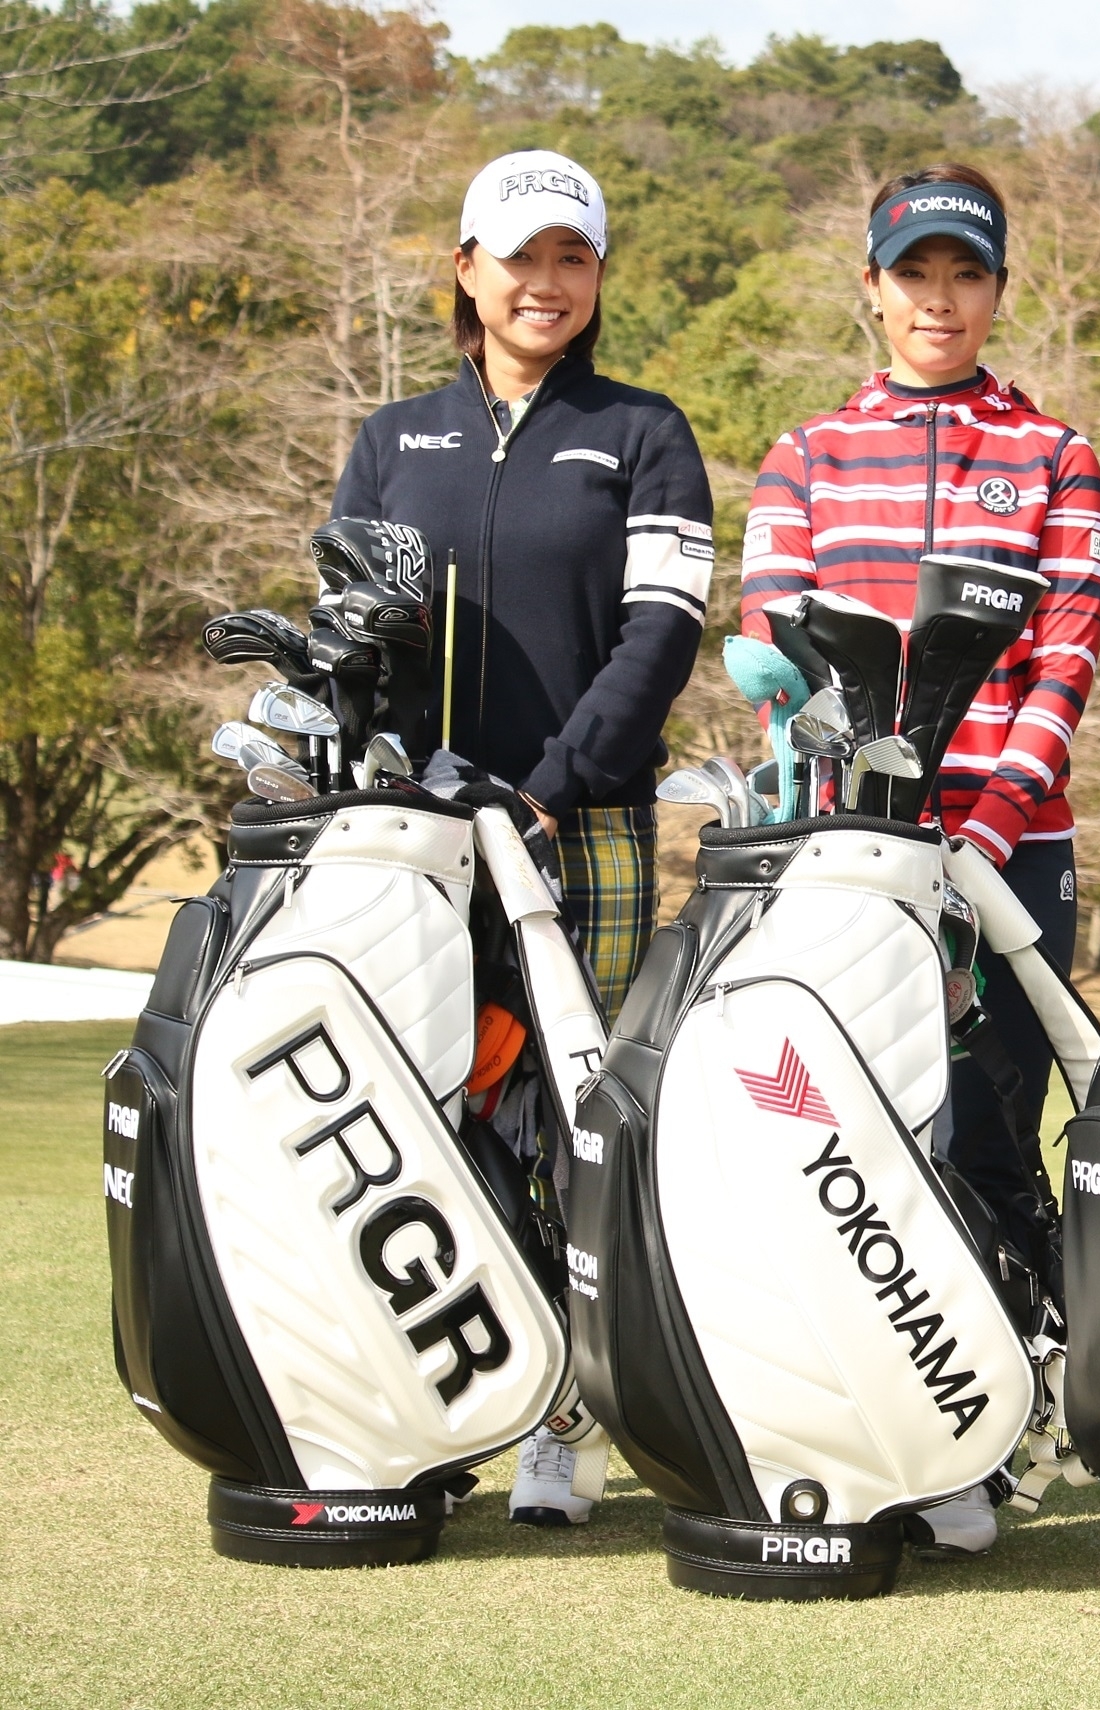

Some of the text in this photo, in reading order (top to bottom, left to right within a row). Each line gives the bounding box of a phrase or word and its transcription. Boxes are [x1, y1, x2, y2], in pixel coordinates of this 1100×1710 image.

[499, 169, 590, 207] PRGR
[909, 195, 993, 226] YOKOHAMA
[399, 431, 463, 452] NEC
[381, 519, 426, 603] RS
[960, 581, 1025, 612] PRGR
[108, 1101, 140, 1140] PRGR
[104, 1162, 135, 1209] NEC
[246, 1021, 512, 1407] PRGR
[802, 1131, 990, 1441] YOKOHAMA
[324, 1503, 417, 1523] YOKOHAMA
[761, 1536, 852, 1564] PRGR
